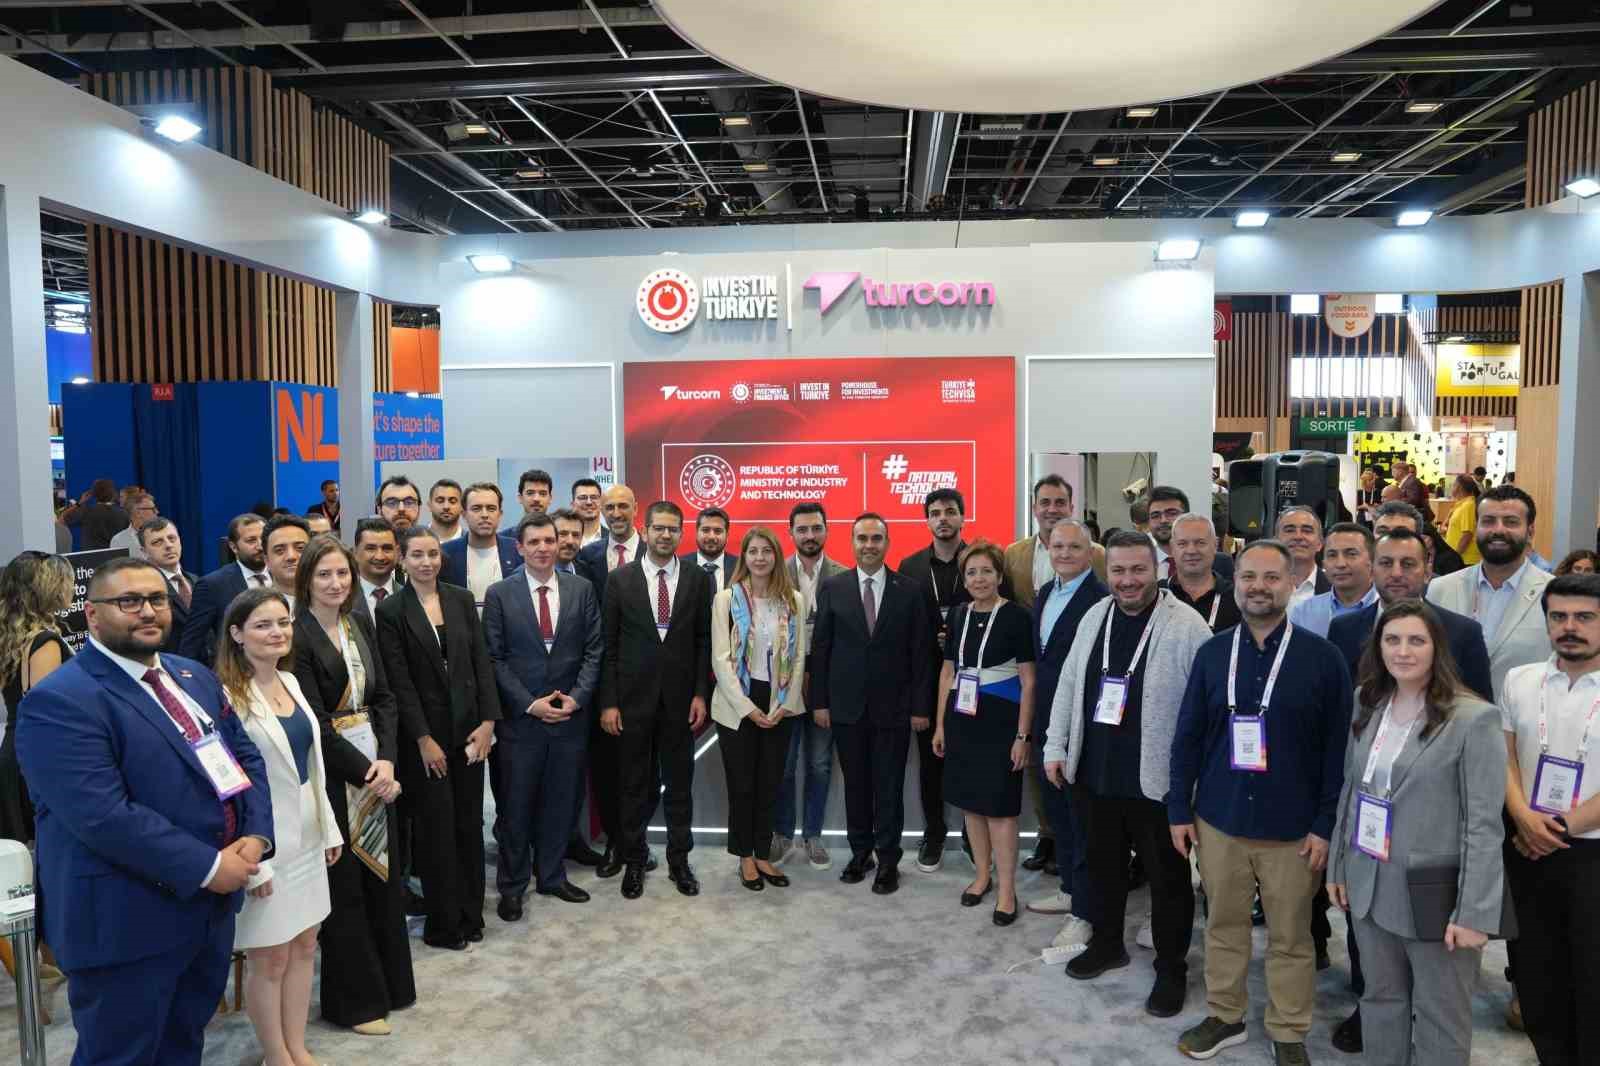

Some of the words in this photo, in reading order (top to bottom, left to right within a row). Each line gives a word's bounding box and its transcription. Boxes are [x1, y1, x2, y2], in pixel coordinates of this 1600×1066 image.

[864, 278, 996, 307] turcorn
[676, 388, 720, 400] turcorn
[277, 389, 340, 463] NL
[391, 409, 422, 438] shape
[424, 412, 440, 432] the
[1310, 420, 1356, 432] SORTIE
[398, 439, 440, 461] together
[740, 465, 784, 475] REPUBLIC
[786, 465, 799, 475] OF
[740, 477, 784, 488] MINISTRY
[786, 477, 799, 487] OF
[800, 477, 848, 488] INDUSTRY
[908, 471, 957, 483] NATIONAL
[740, 490, 762, 500] AND
[762, 489, 826, 500] TECHNOLOGY
[76, 567, 95, 580] the
[74, 583, 87, 595] to
